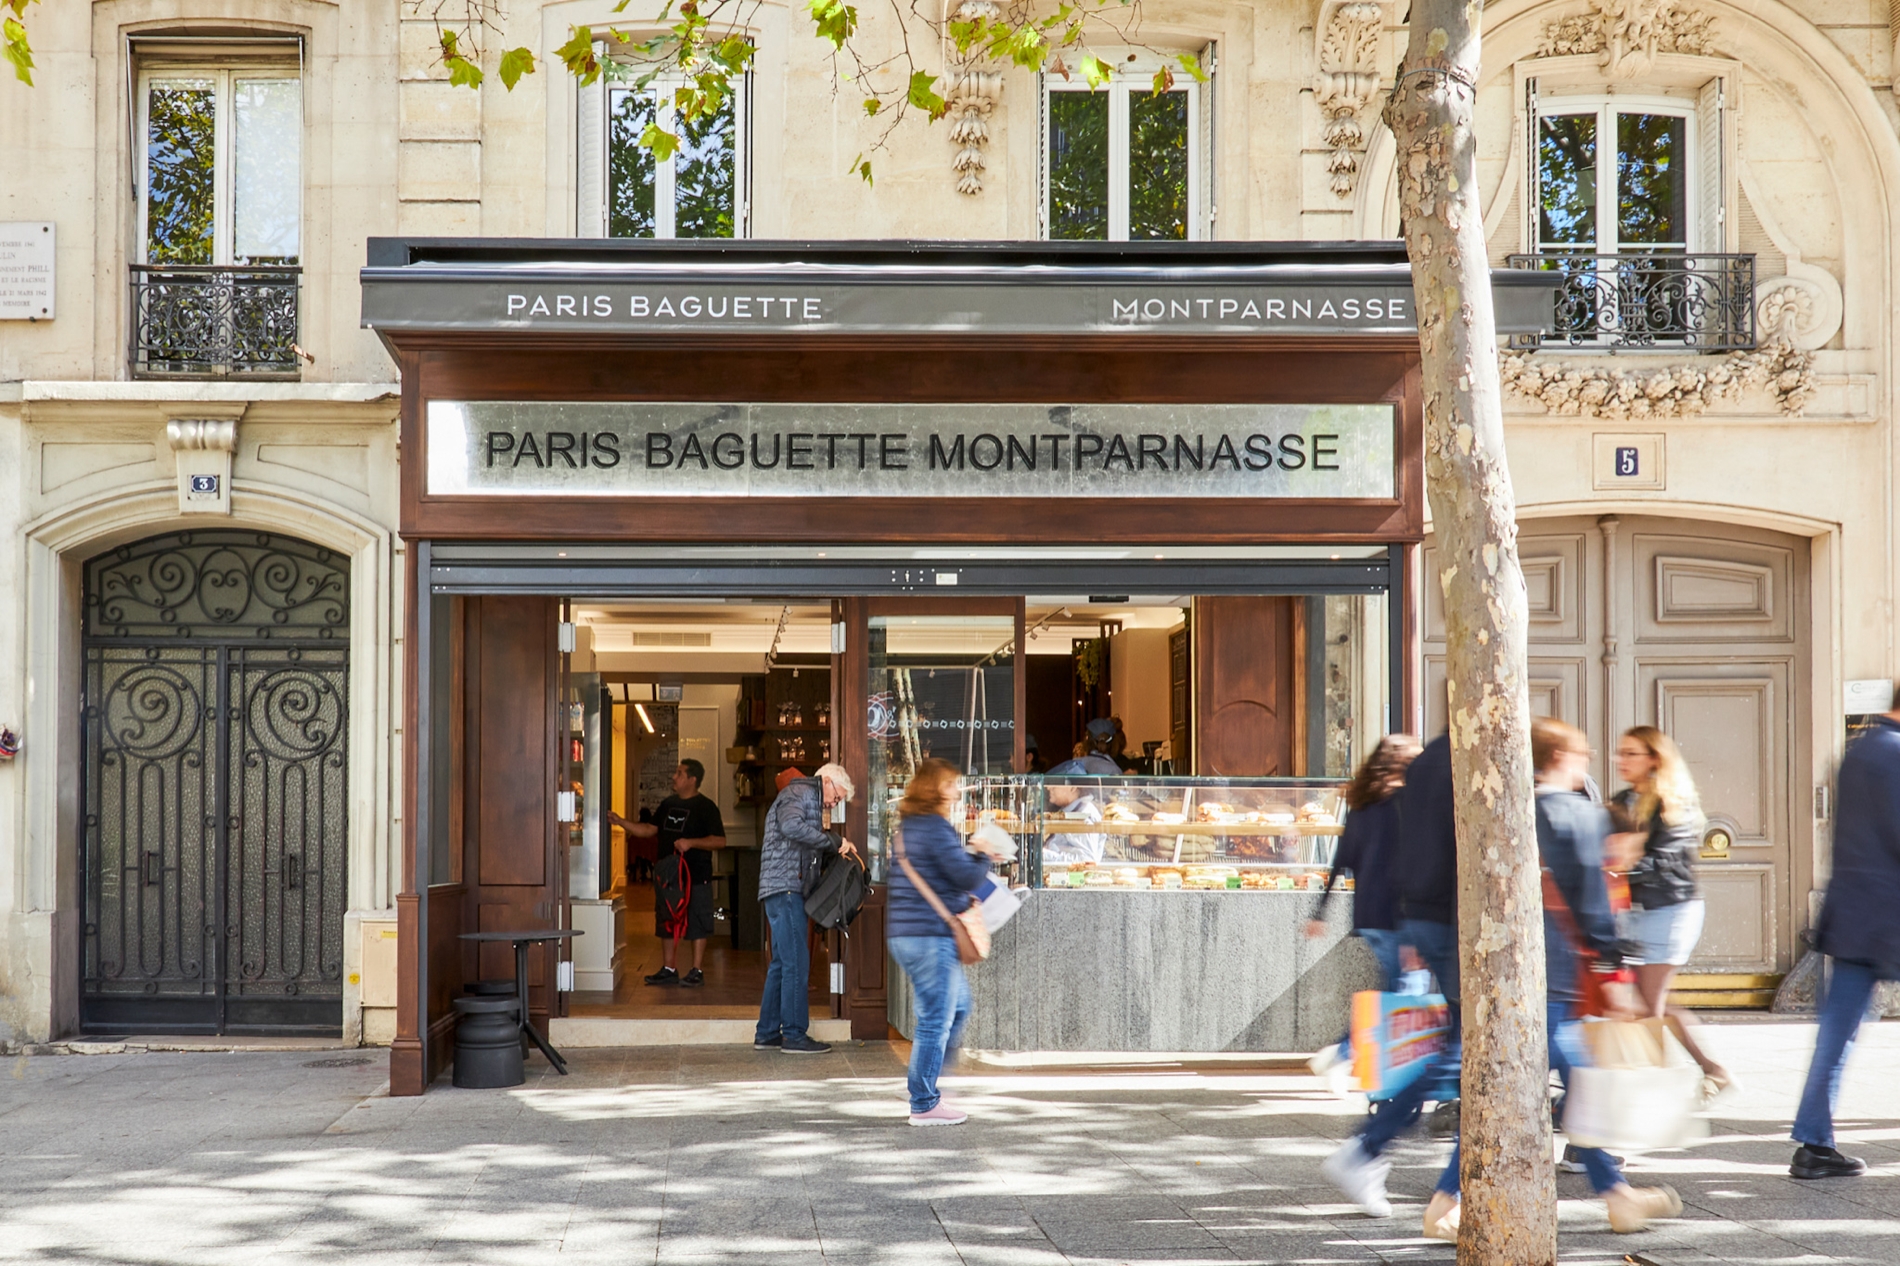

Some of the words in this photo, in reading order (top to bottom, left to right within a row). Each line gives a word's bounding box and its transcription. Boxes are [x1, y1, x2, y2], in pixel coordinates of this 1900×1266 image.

[507, 294, 613, 317] PARIS
[630, 296, 822, 319] BAGUETTE
[1113, 298, 1406, 320] MONTPARNASSE
[487, 431, 621, 469] PARIS
[645, 432, 908, 471] BAGUETTE
[928, 433, 1339, 472] MONTPARNASSE
[1621, 449, 1636, 474] 5
[199, 478, 209, 490] 3
